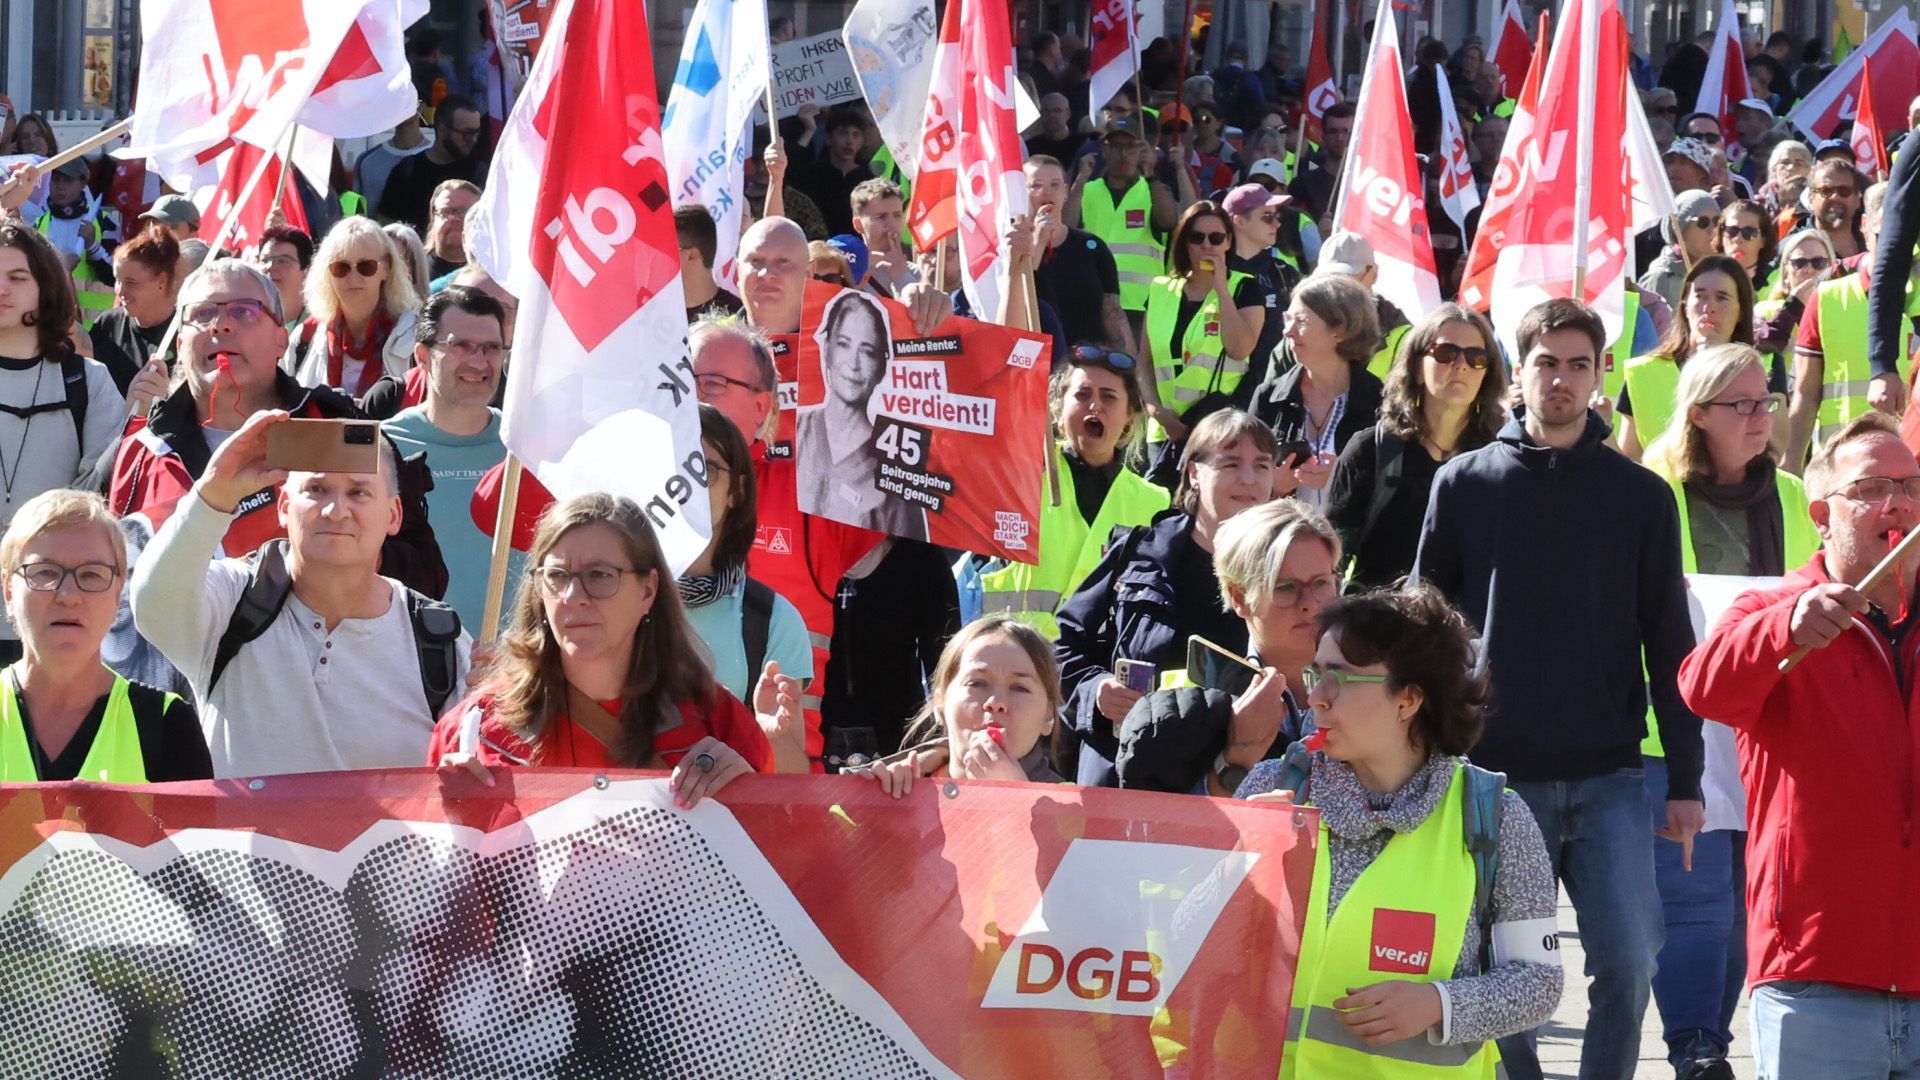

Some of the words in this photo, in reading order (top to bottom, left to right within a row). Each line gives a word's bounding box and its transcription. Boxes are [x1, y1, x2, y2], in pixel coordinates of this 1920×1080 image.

[801, 38, 845, 59] IHREN
[774, 60, 825, 87] PROFIT
[817, 76, 854, 96] WIR
[896, 341, 926, 354] Meine
[926, 338, 958, 352] Rente:
[1011, 354, 1032, 367] DGB
[891, 366, 942, 390] Hart
[882, 393, 989, 427] verdient!
[875, 423, 922, 466] 45
[880, 463, 952, 492] Beitragsjahre
[879, 477, 904, 494] sind
[904, 487, 940, 511] genug
[997, 512, 1020, 522] MACH
[1001, 521, 1028, 534] DICH
[995, 530, 1019, 541] STARK
[1374, 944, 1429, 968] ver.di
[1016, 943, 1164, 1003] DGB
